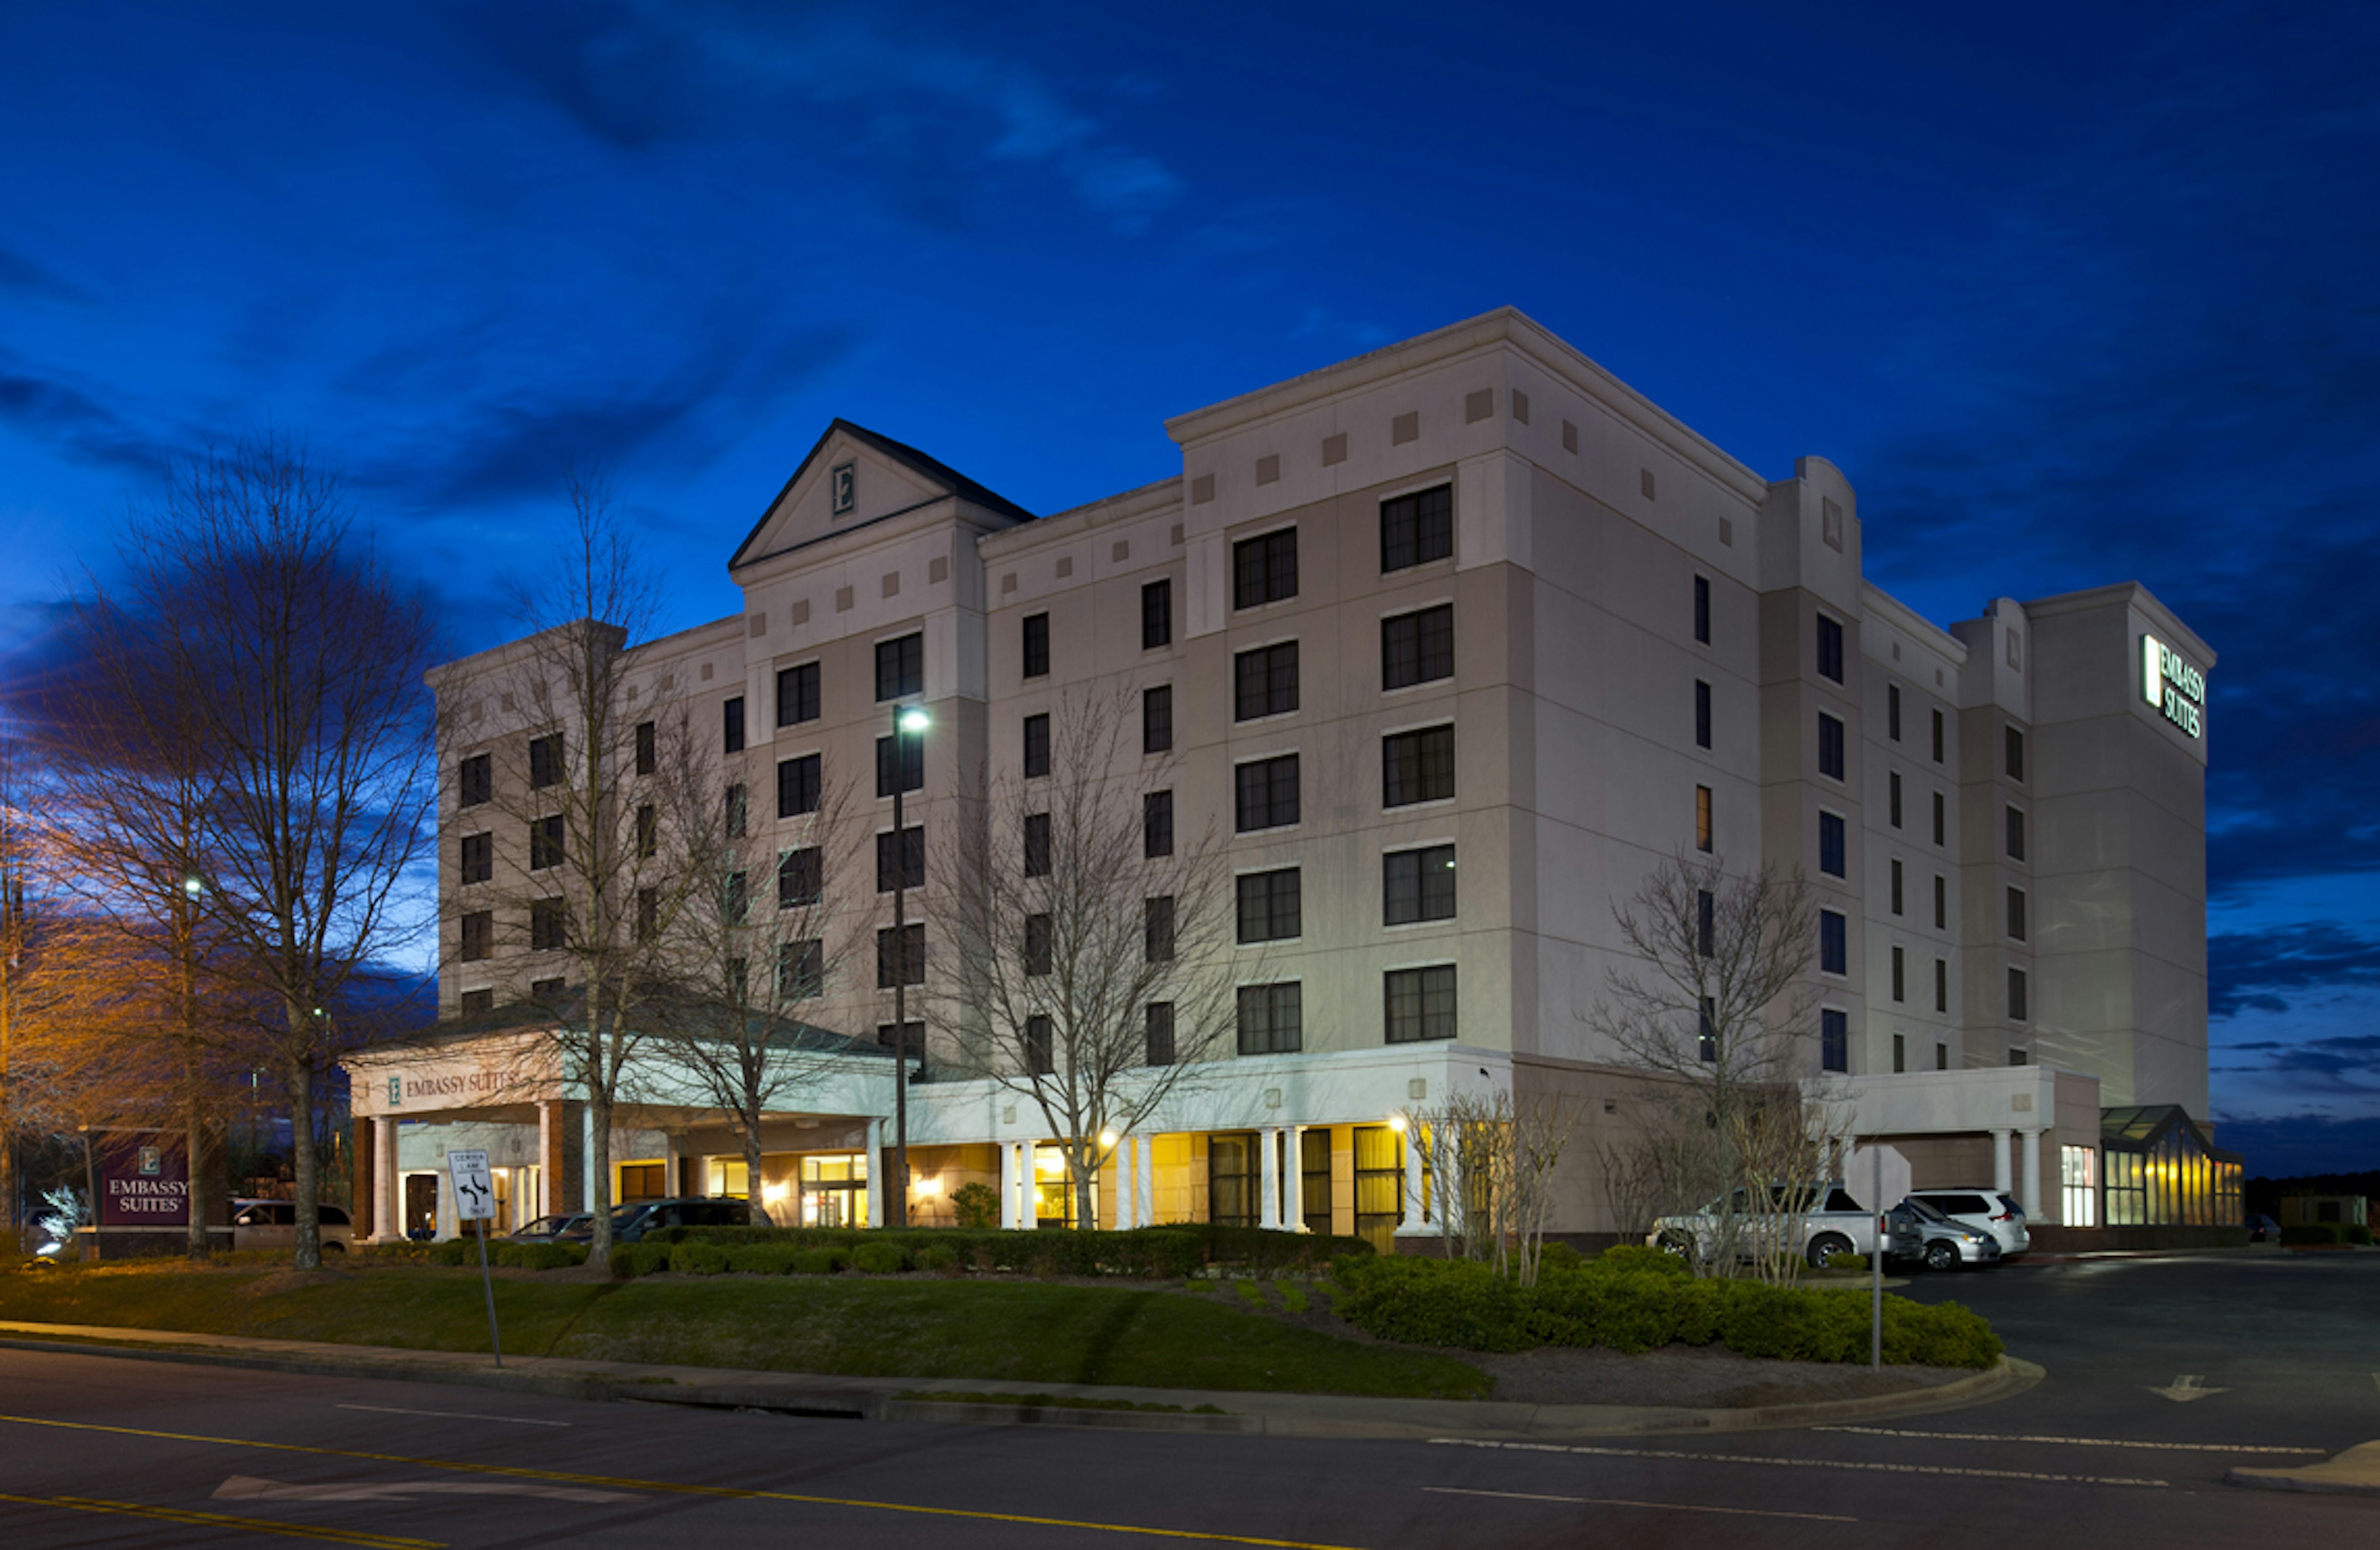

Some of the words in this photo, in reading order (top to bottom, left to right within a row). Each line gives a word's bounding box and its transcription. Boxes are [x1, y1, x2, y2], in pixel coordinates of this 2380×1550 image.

[2164, 686, 2200, 739] SUITES
[407, 1076, 466, 1097] EMBASSY
[469, 1071, 515, 1091] SUITES
[109, 1179, 188, 1195] EMBASSY
[120, 1197, 179, 1212] SUITES
